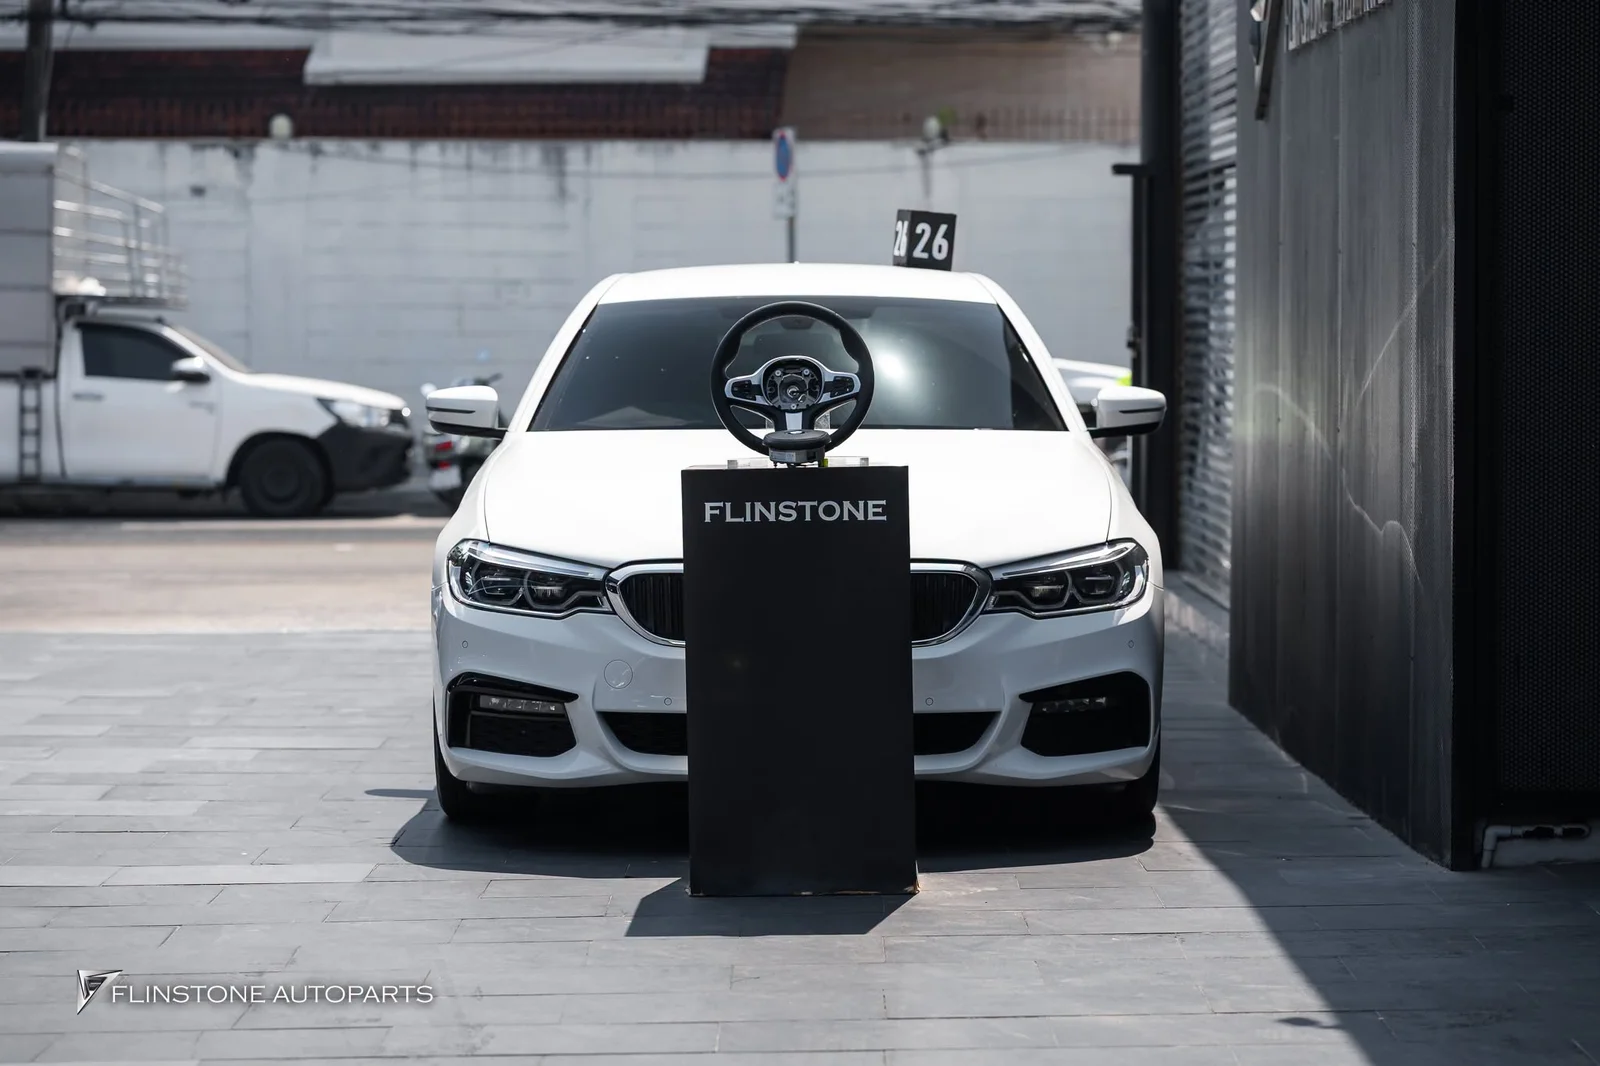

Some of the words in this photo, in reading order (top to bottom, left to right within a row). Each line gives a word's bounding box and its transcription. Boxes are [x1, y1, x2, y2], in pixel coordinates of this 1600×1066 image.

[893, 220, 909, 257] 26
[912, 222, 949, 261] 26
[704, 500, 887, 523] FLINSTONE
